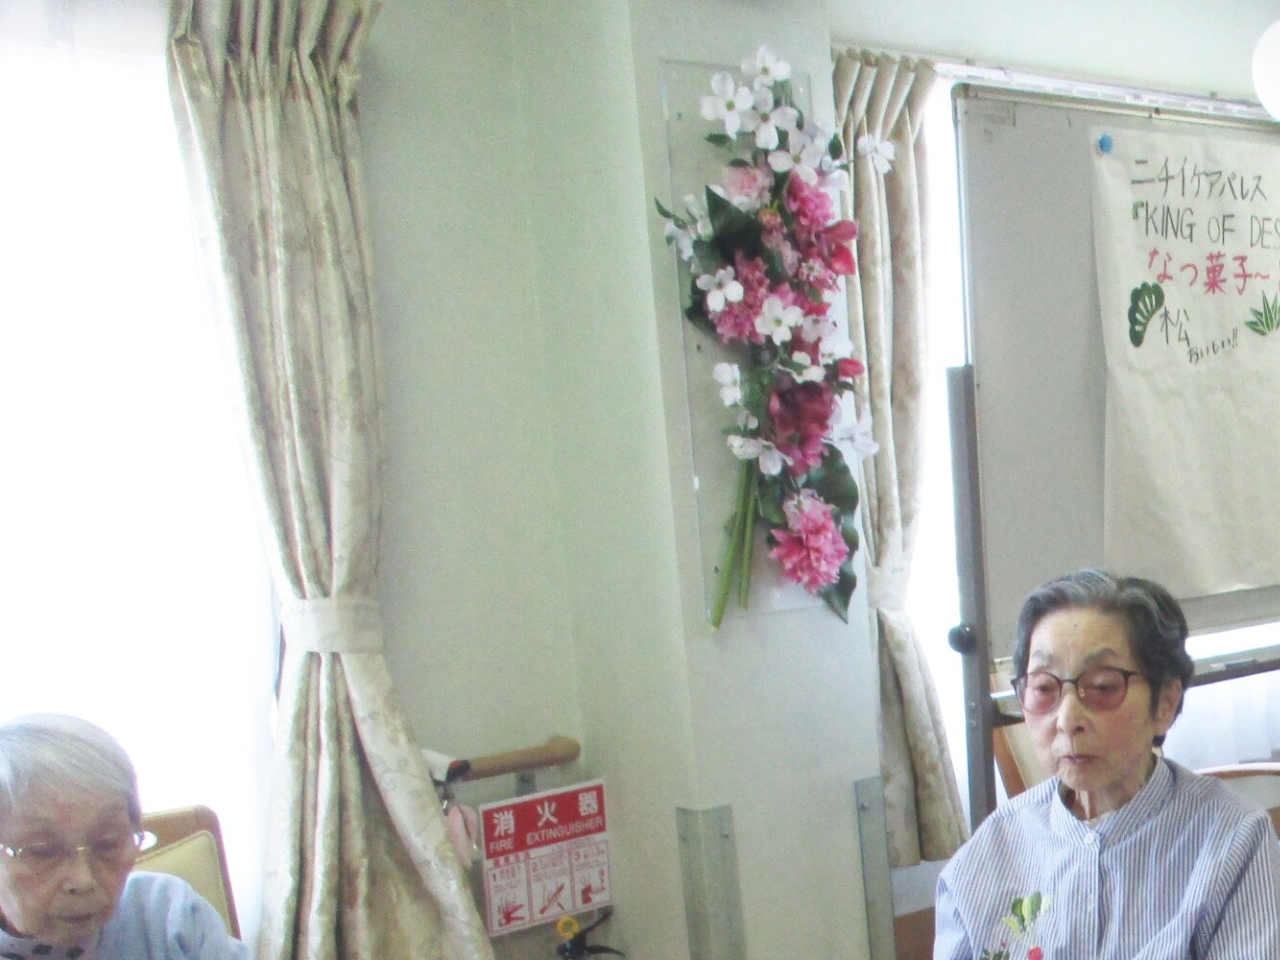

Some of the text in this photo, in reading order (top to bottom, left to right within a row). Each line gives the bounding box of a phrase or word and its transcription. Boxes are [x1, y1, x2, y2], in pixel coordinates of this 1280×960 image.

[1207, 214, 1236, 246] OF
[489, 815, 604, 853] FIRE EXTINGUISHER
